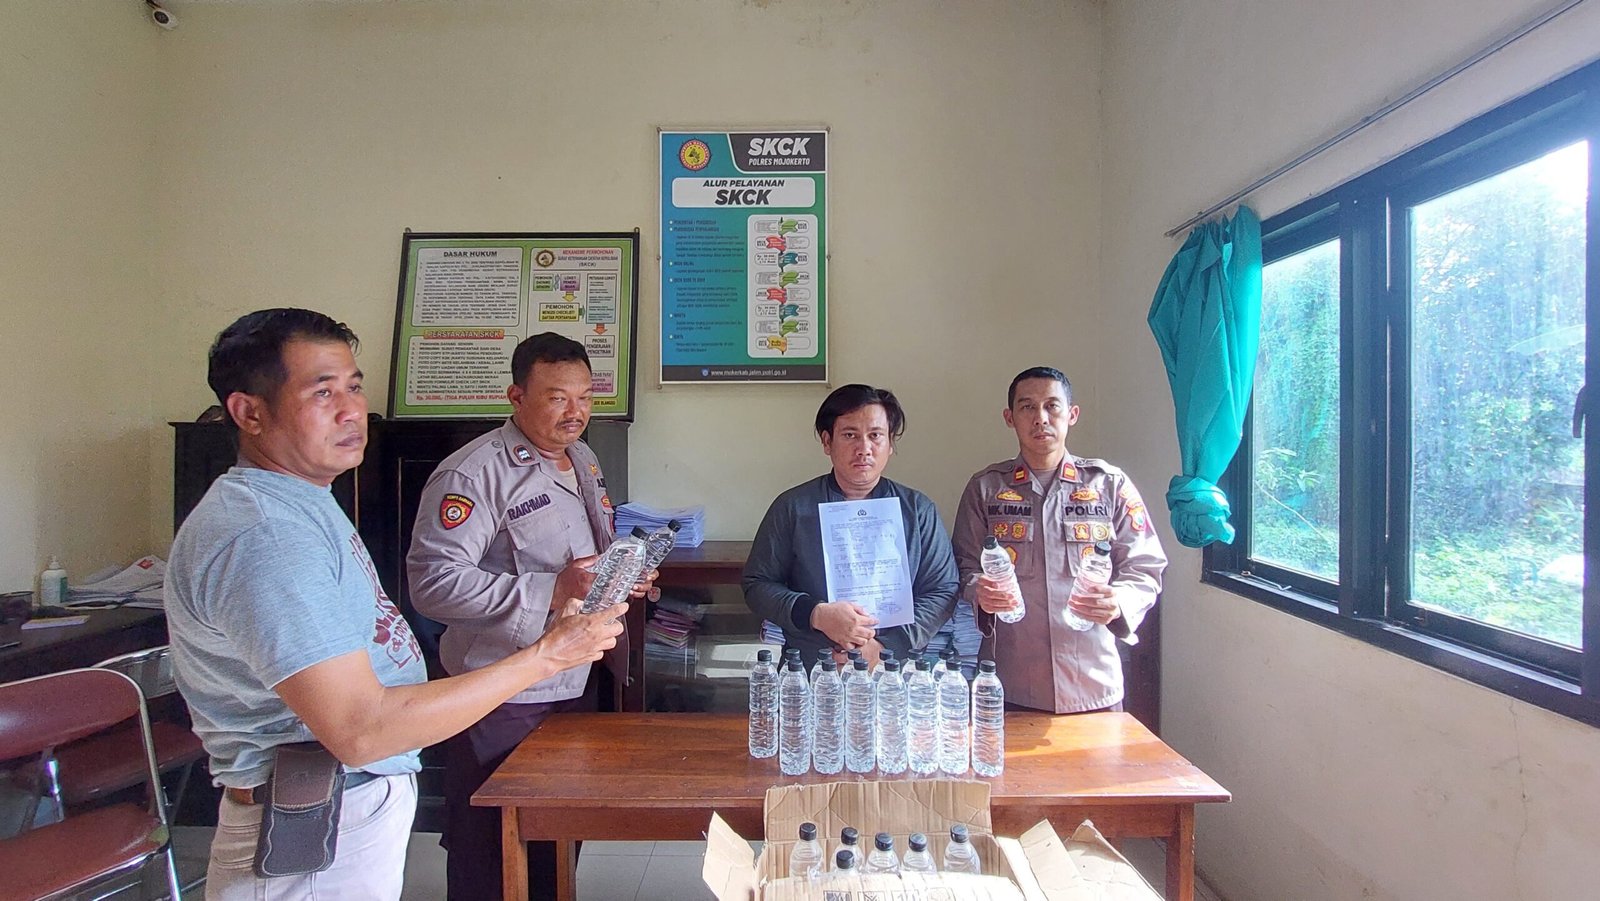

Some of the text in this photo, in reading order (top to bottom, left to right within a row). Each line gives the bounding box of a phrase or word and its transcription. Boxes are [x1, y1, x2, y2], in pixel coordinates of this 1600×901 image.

[748, 137, 810, 156] SKCK
[773, 158, 810, 166] MOJOKERTO
[715, 189, 772, 205] SKCK
[507, 493, 551, 520] RAKHMAD
[1004, 505, 1032, 516] UMAM
[1064, 505, 1108, 516] POLRI
